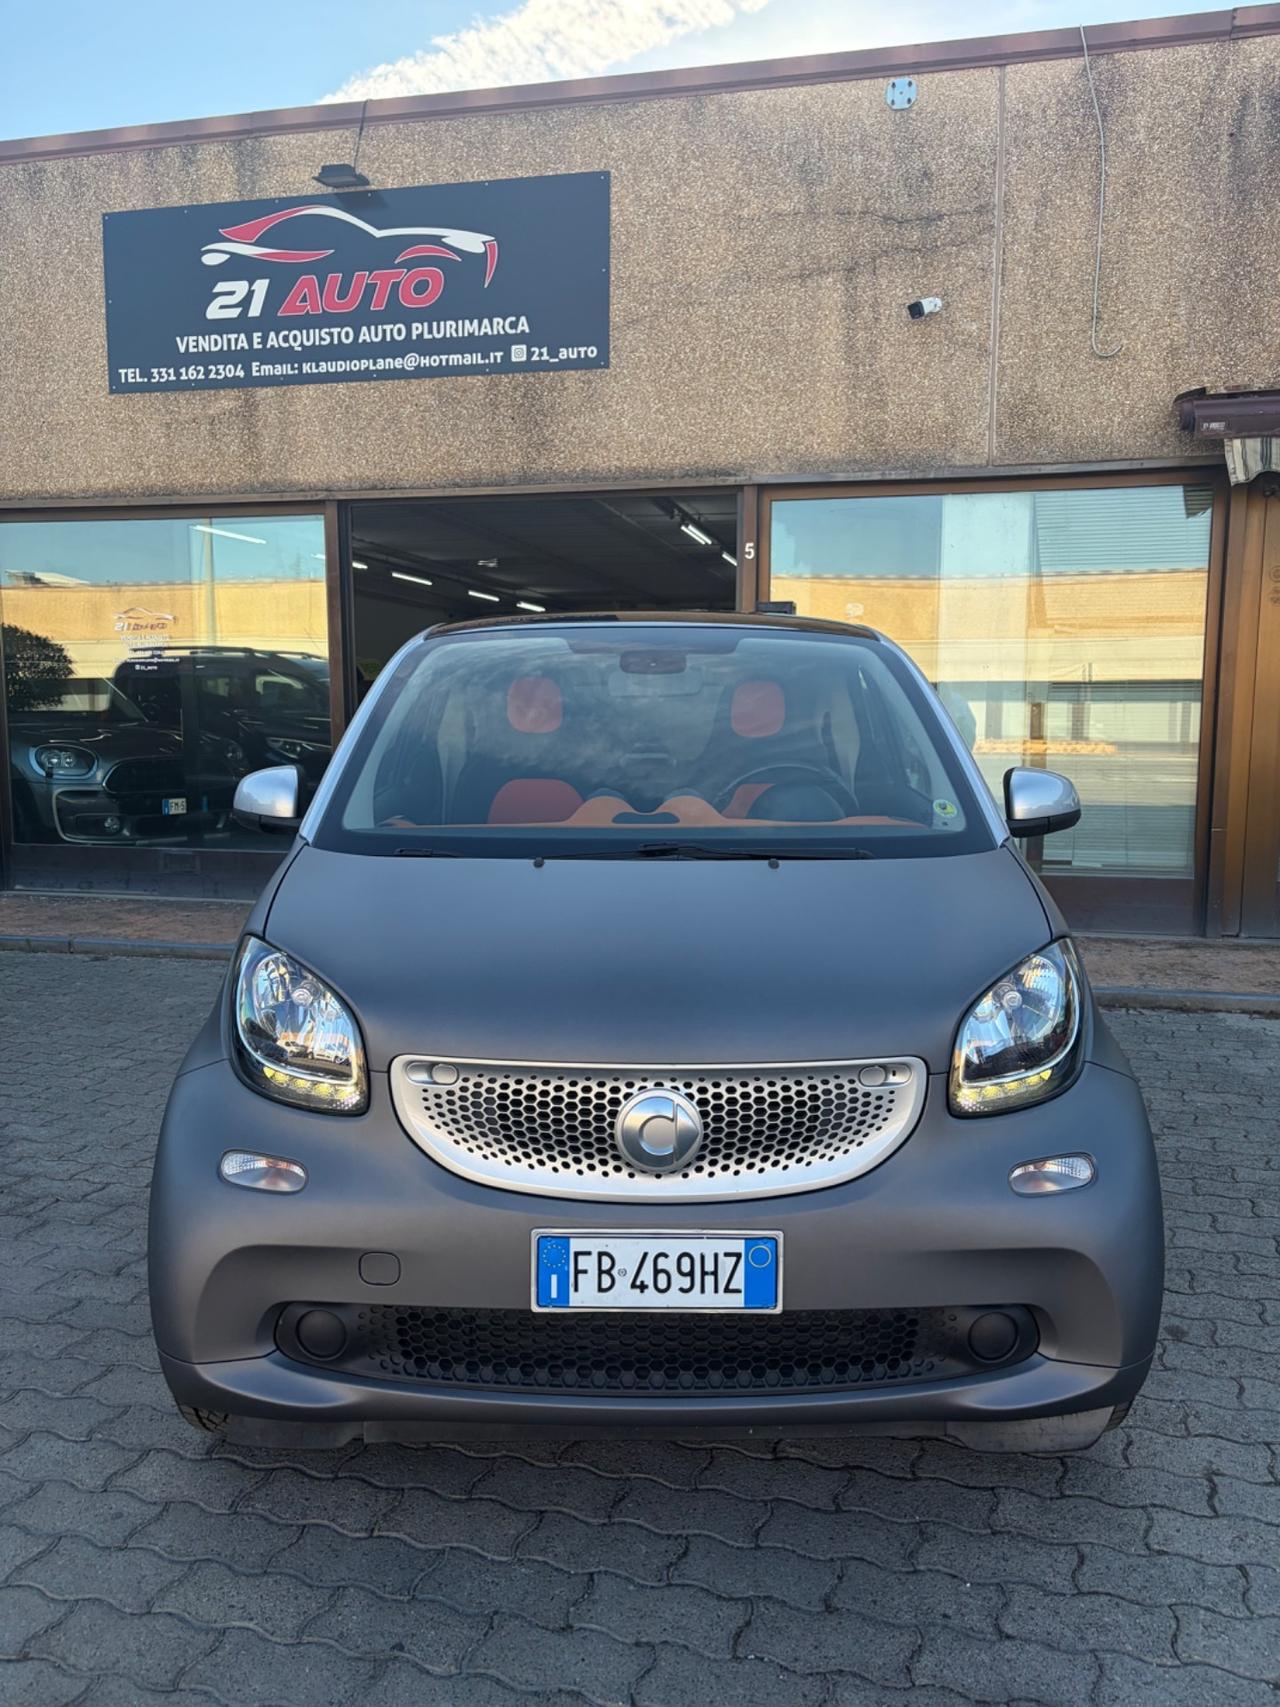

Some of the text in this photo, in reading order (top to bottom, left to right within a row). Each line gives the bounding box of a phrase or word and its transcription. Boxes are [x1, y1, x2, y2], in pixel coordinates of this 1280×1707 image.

[205, 266, 445, 320] 21 AUTO
[175, 316, 530, 353] VENDITA E ACQUISTO AUTO PLURIMARCA
[118, 368, 147, 383] TEL.
[150, 367, 176, 382] 331
[180, 365, 205, 380] 162
[209, 364, 244, 379] 2304
[744, 542, 755, 559] 5
